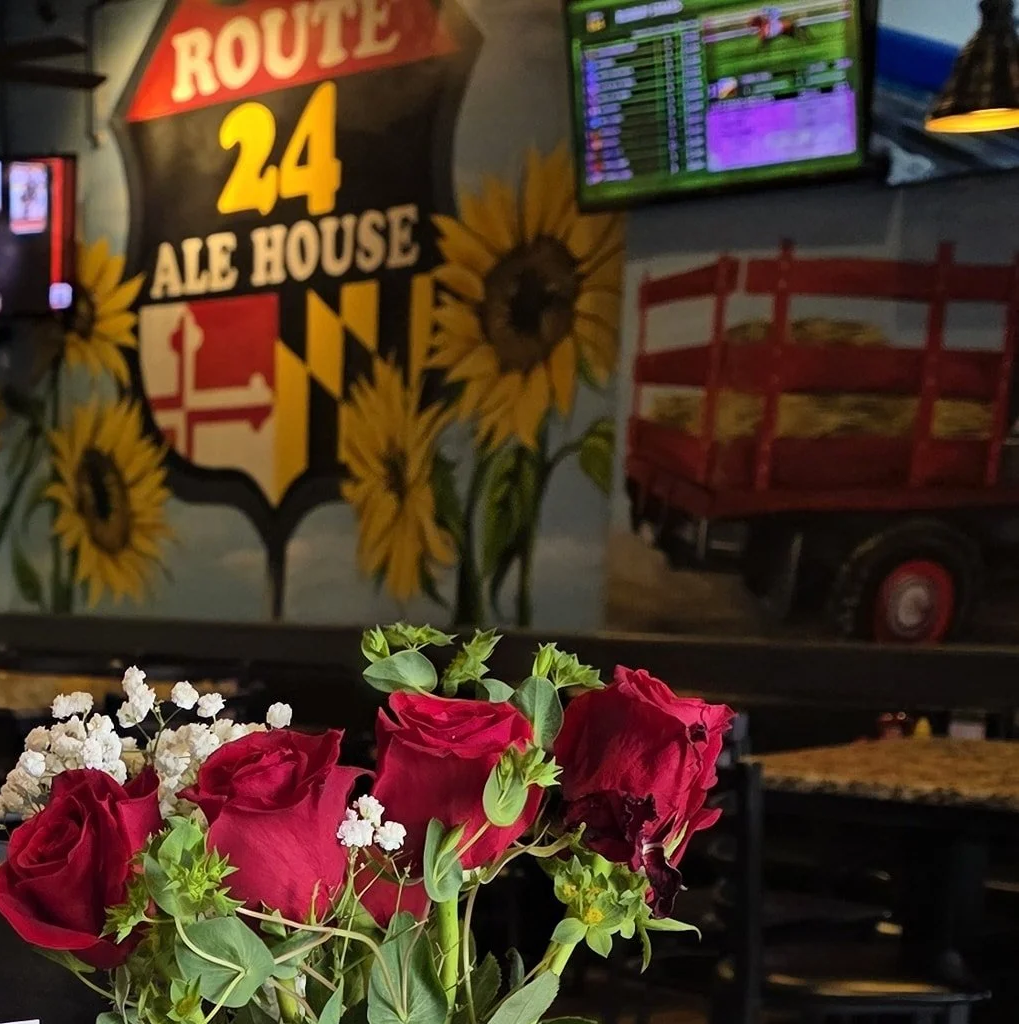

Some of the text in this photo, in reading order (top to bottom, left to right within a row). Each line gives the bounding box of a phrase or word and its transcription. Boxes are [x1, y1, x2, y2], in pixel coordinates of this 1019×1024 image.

[171, 0, 400, 102] ROUTE
[217, 80, 342, 216] 24
[150, 203, 420, 299] ALE HOUSE
